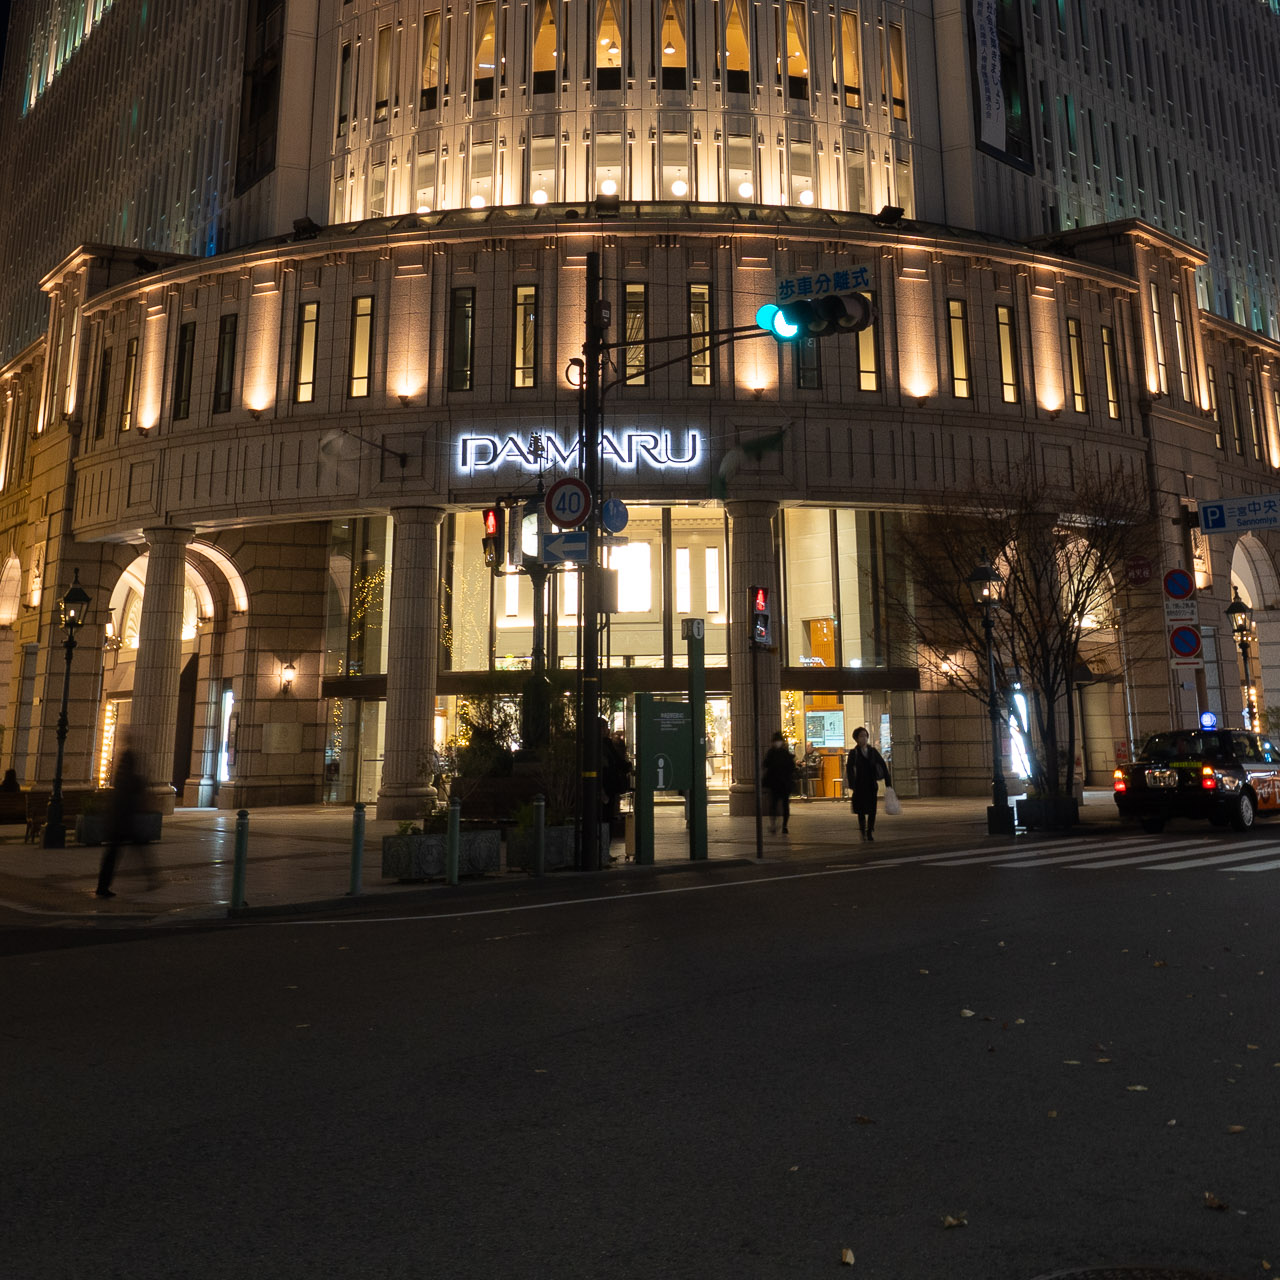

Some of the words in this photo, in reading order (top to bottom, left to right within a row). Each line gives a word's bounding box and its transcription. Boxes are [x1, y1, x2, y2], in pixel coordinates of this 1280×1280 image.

[778, 266, 870, 300] 歩車分離式
[461, 433, 698, 468] DAMARU
[556, 491, 581, 514] 40
[1207, 507, 1220, 528] P
